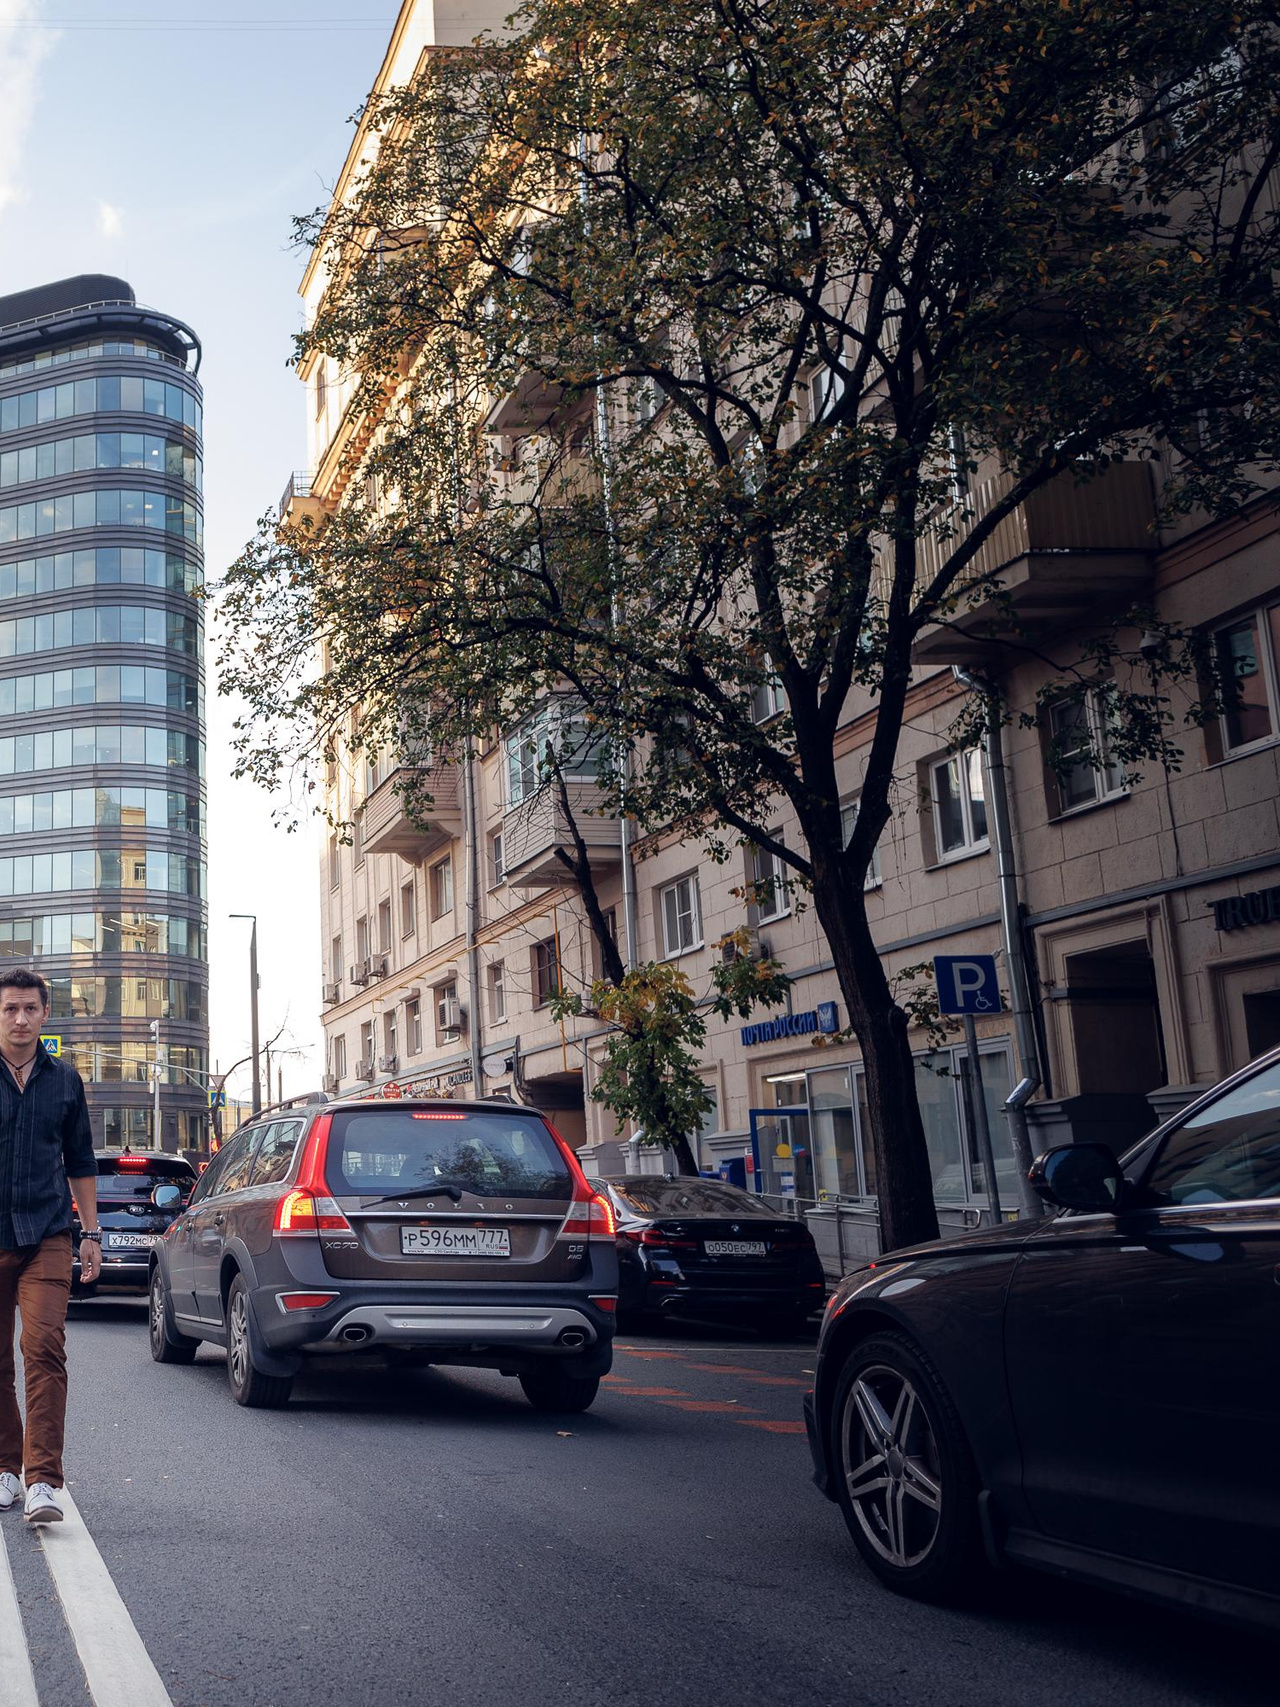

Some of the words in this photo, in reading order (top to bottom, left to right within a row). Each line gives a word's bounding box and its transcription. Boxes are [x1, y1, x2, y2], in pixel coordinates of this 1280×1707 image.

[952, 962, 986, 1007] P
[741, 1021, 774, 1046] ПОЧТА
[773, 1010, 819, 1040] РОССИИ
[398, 1202, 513, 1211] VOLVO
[478, 1230, 504, 1243] 777
